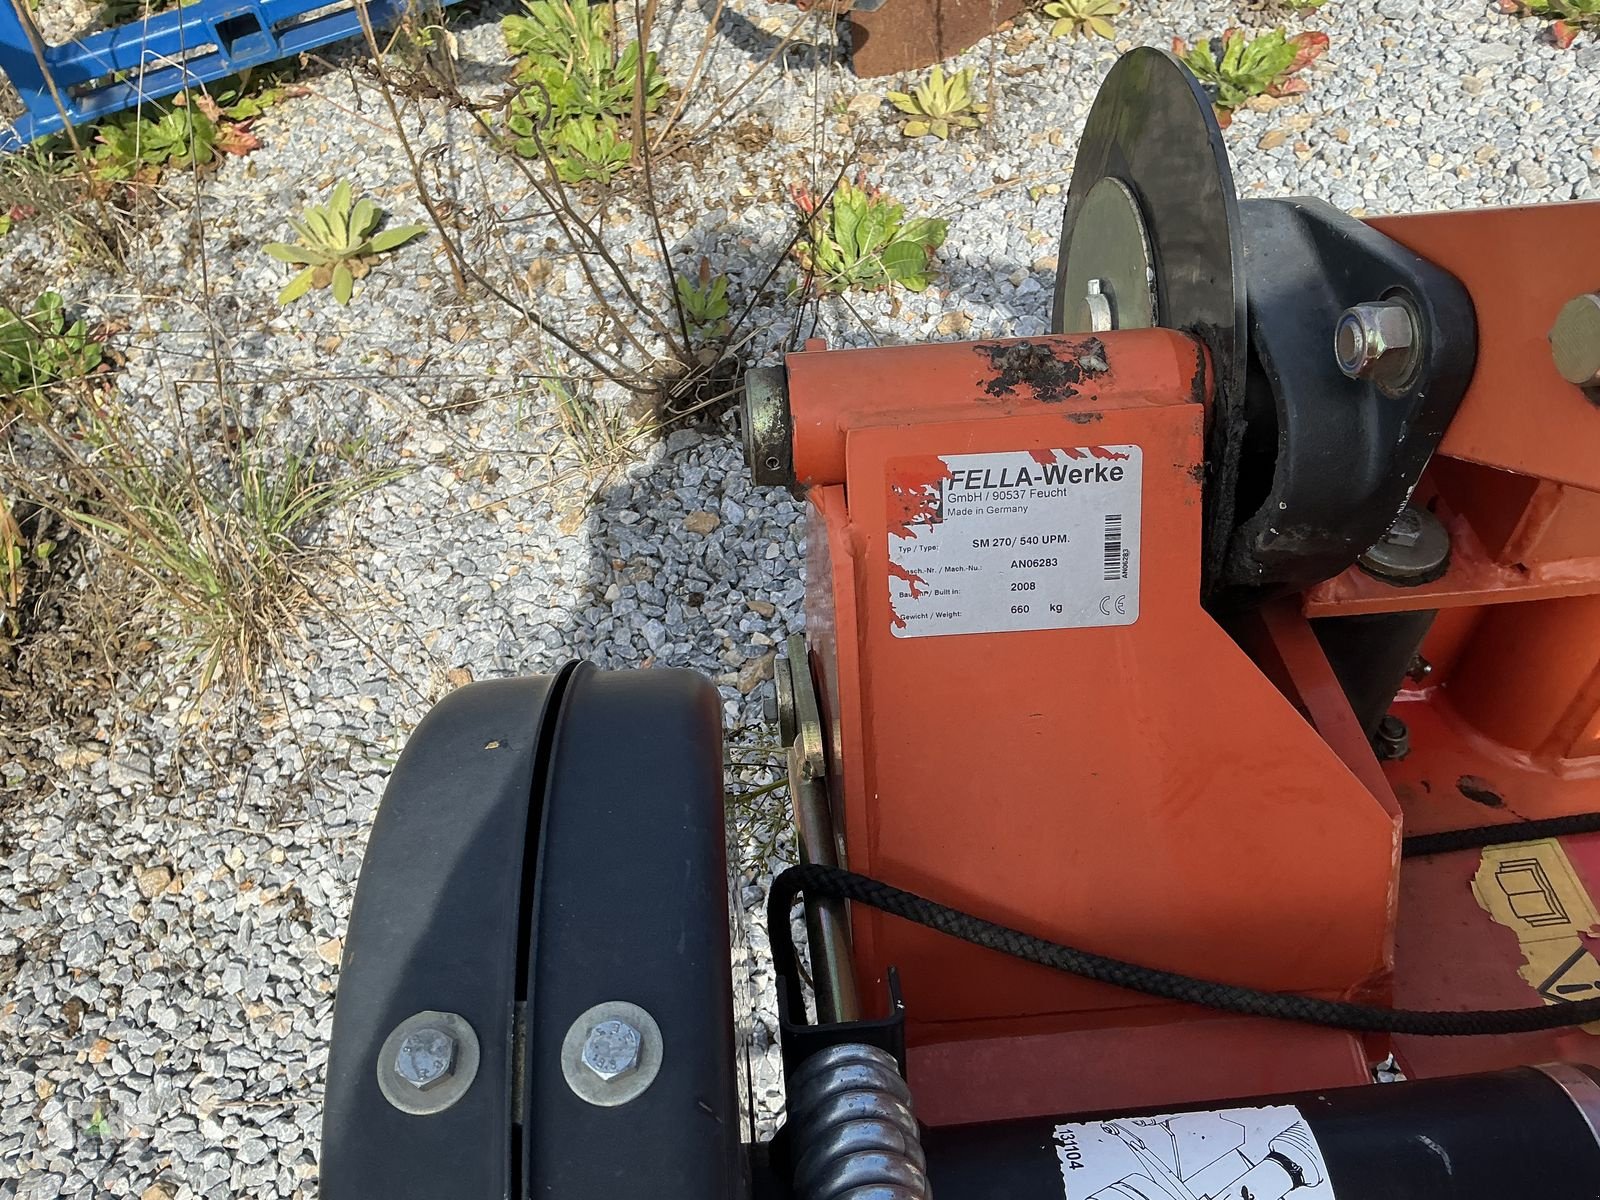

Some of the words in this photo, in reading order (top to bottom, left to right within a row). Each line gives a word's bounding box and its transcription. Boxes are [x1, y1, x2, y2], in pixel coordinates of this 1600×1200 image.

[948, 463, 1124, 490] FELLA-Werke
[948, 493, 982, 504] GmbH
[985, 492, 989, 501] /
[993, 490, 1026, 500] 90537
[1029, 487, 1067, 498] Feucht
[948, 507, 972, 516] Made
[976, 506, 983, 515] in
[987, 505, 1028, 515] Germany
[972, 538, 990, 548] SM
[1020, 536, 1039, 546] 540
[1042, 535, 1070, 544] UPM.
[1010, 558, 1058, 569] AN06283
[1122, 548, 1130, 579] AN06283
[1010, 582, 1036, 592] 2008
[1010, 605, 1030, 614] 660
[1050, 603, 1063, 613] kg
[900, 611, 928, 620] Gewicht
[1057, 1128, 1084, 1171] 131104
